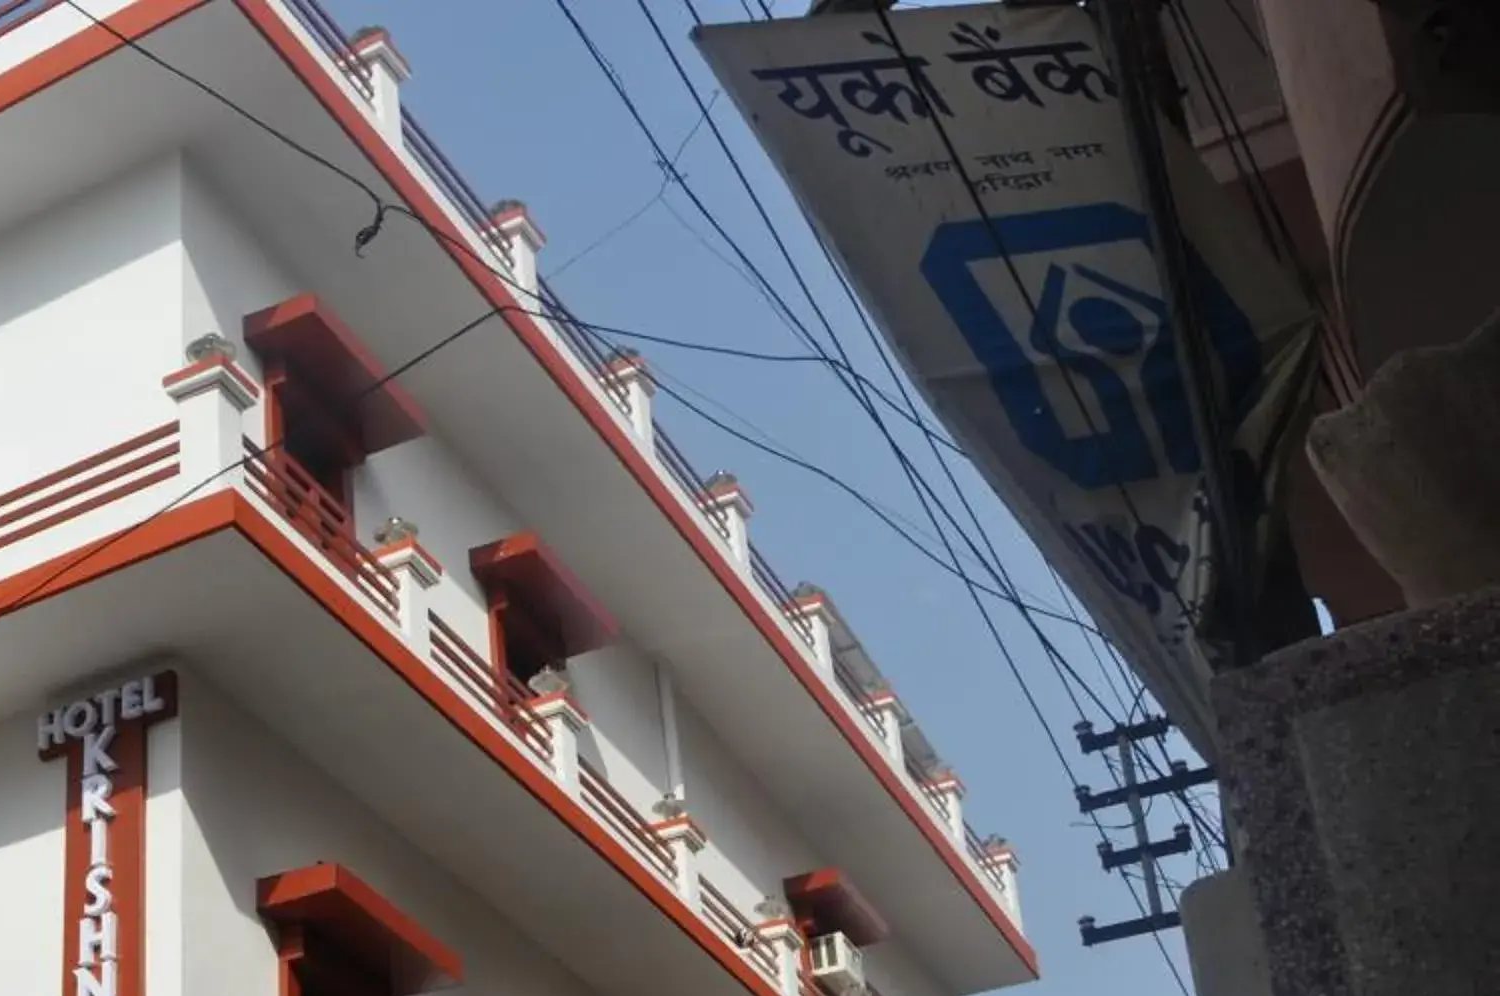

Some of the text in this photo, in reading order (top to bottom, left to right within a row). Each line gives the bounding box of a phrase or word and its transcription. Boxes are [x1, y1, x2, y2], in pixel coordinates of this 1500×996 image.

[751, 21, 1118, 157] यूको बैंक
[37, 675, 164, 750] HOTEL
